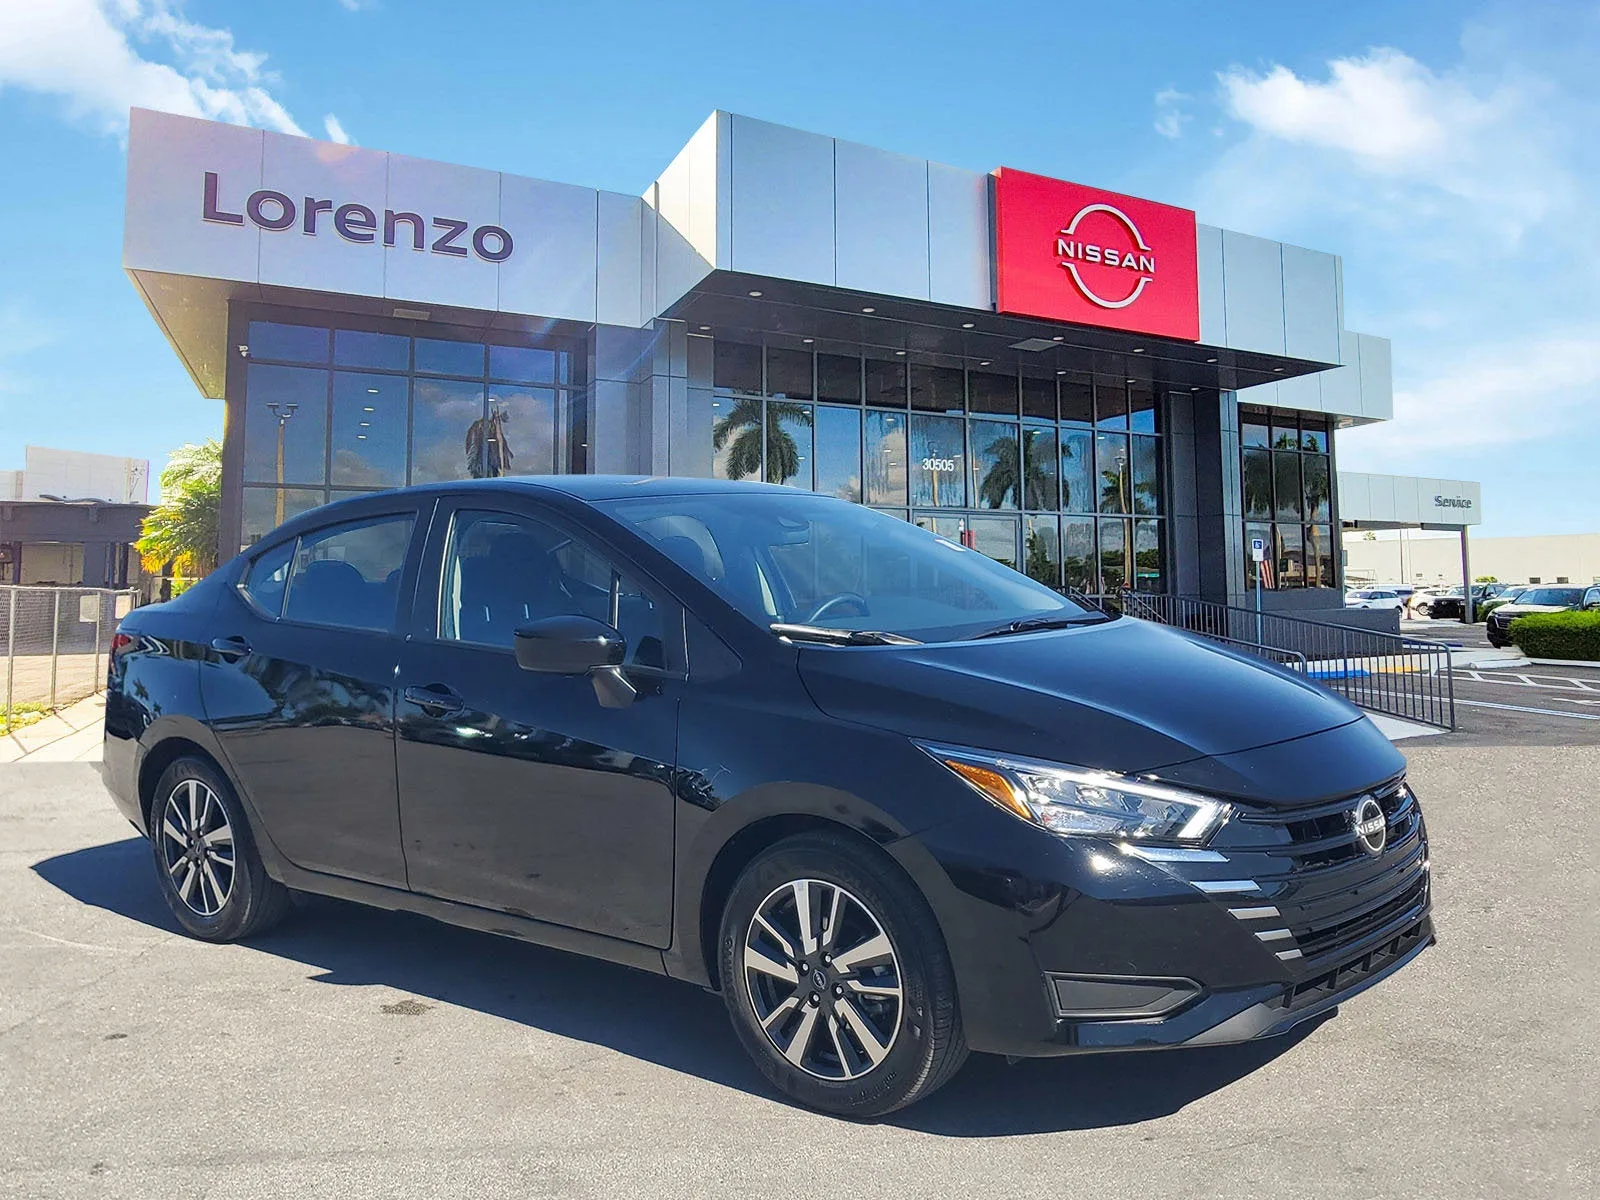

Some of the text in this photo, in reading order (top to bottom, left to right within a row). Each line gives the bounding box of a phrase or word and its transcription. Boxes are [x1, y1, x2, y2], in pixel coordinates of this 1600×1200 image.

[202, 171, 514, 262] Lorenzo
[1057, 238, 1155, 273] NISSAN
[922, 457, 955, 471] 30505
[1434, 495, 1472, 509] Service
